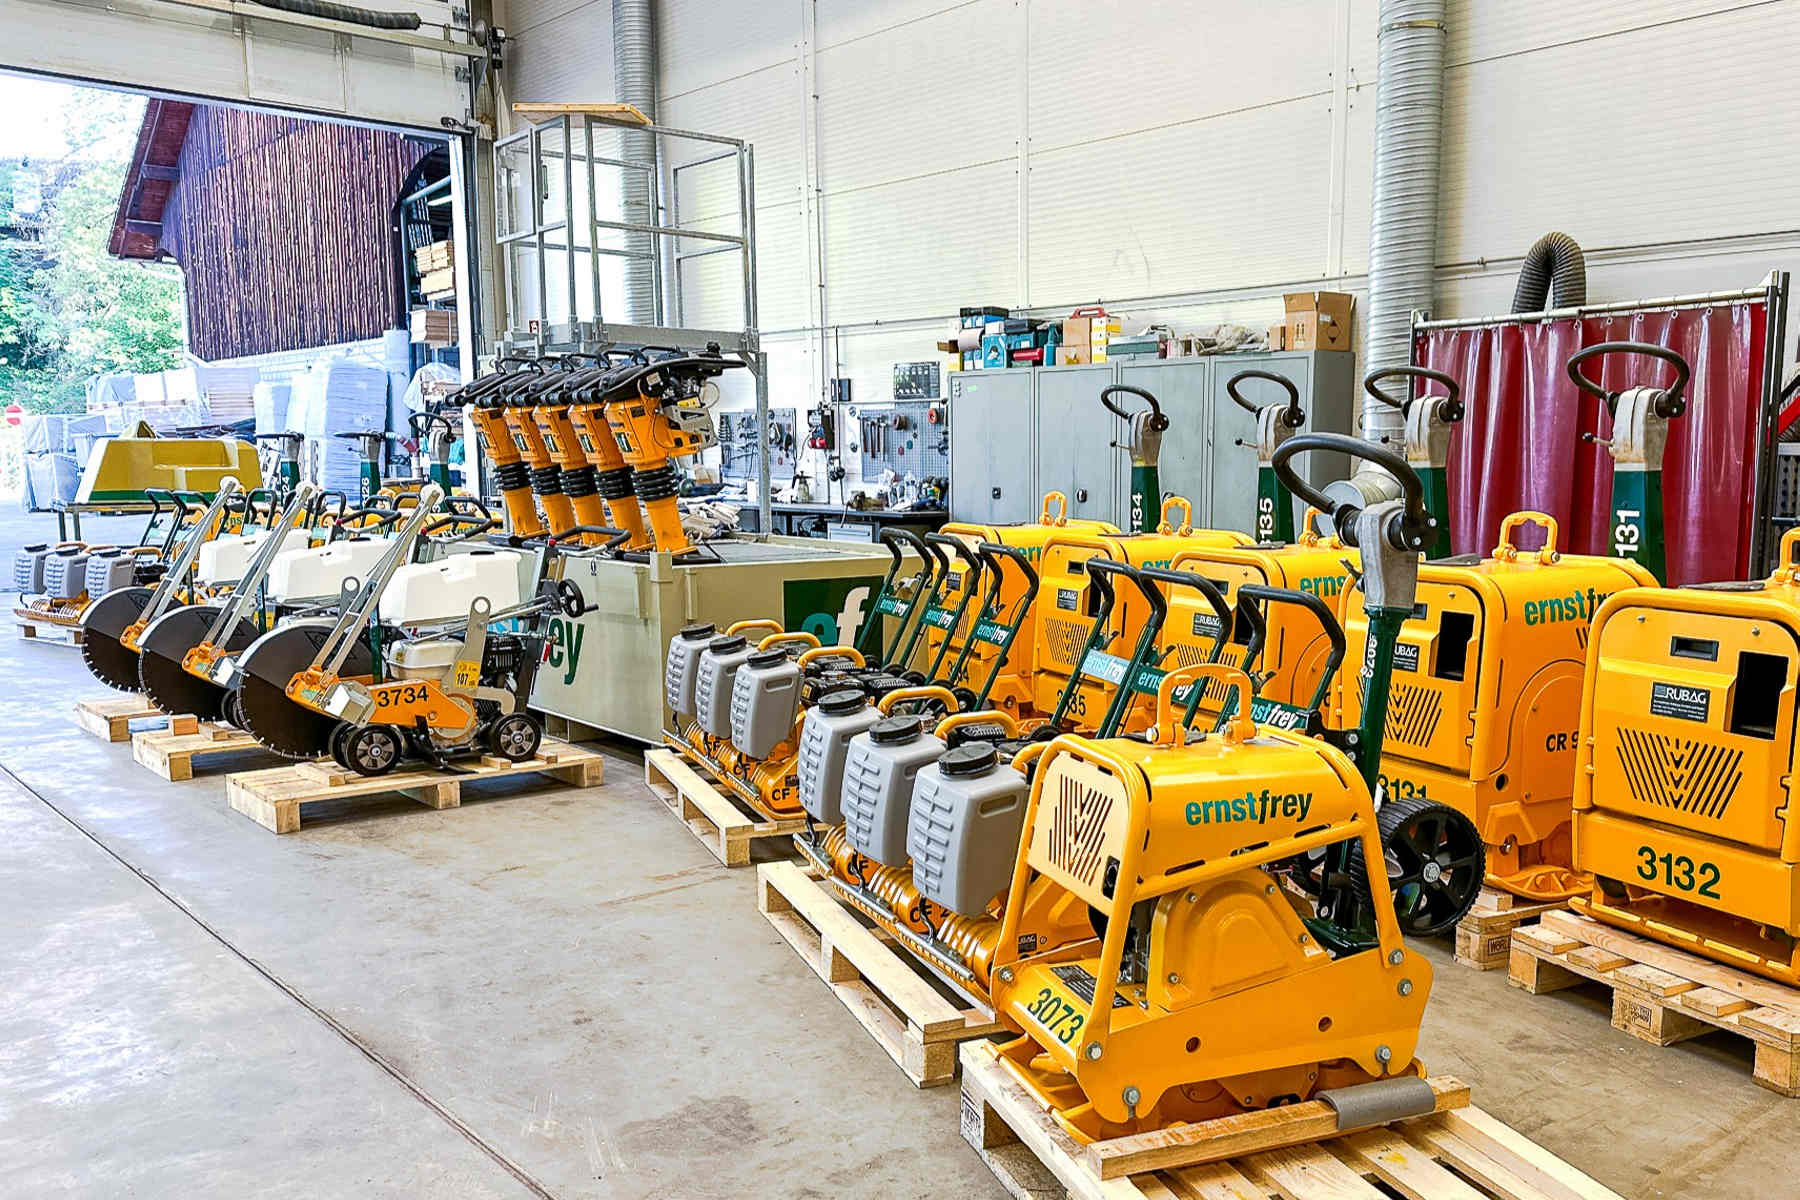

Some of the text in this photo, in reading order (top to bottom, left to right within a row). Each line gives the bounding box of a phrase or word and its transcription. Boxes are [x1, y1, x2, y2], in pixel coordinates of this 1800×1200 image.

[1524, 587, 1616, 626] ernstfr
[976, 623, 1009, 644] ernstfrey
[1394, 645, 1418, 657] UBAG
[377, 685, 429, 708] 3734
[1666, 687, 1707, 704] RUBAG
[1546, 732, 1568, 752] CR
[771, 787, 791, 801] CF
[1185, 788, 1313, 826] ernstfrey
[1636, 845, 1721, 900] 3132
[1027, 988, 1084, 1044] 3073
